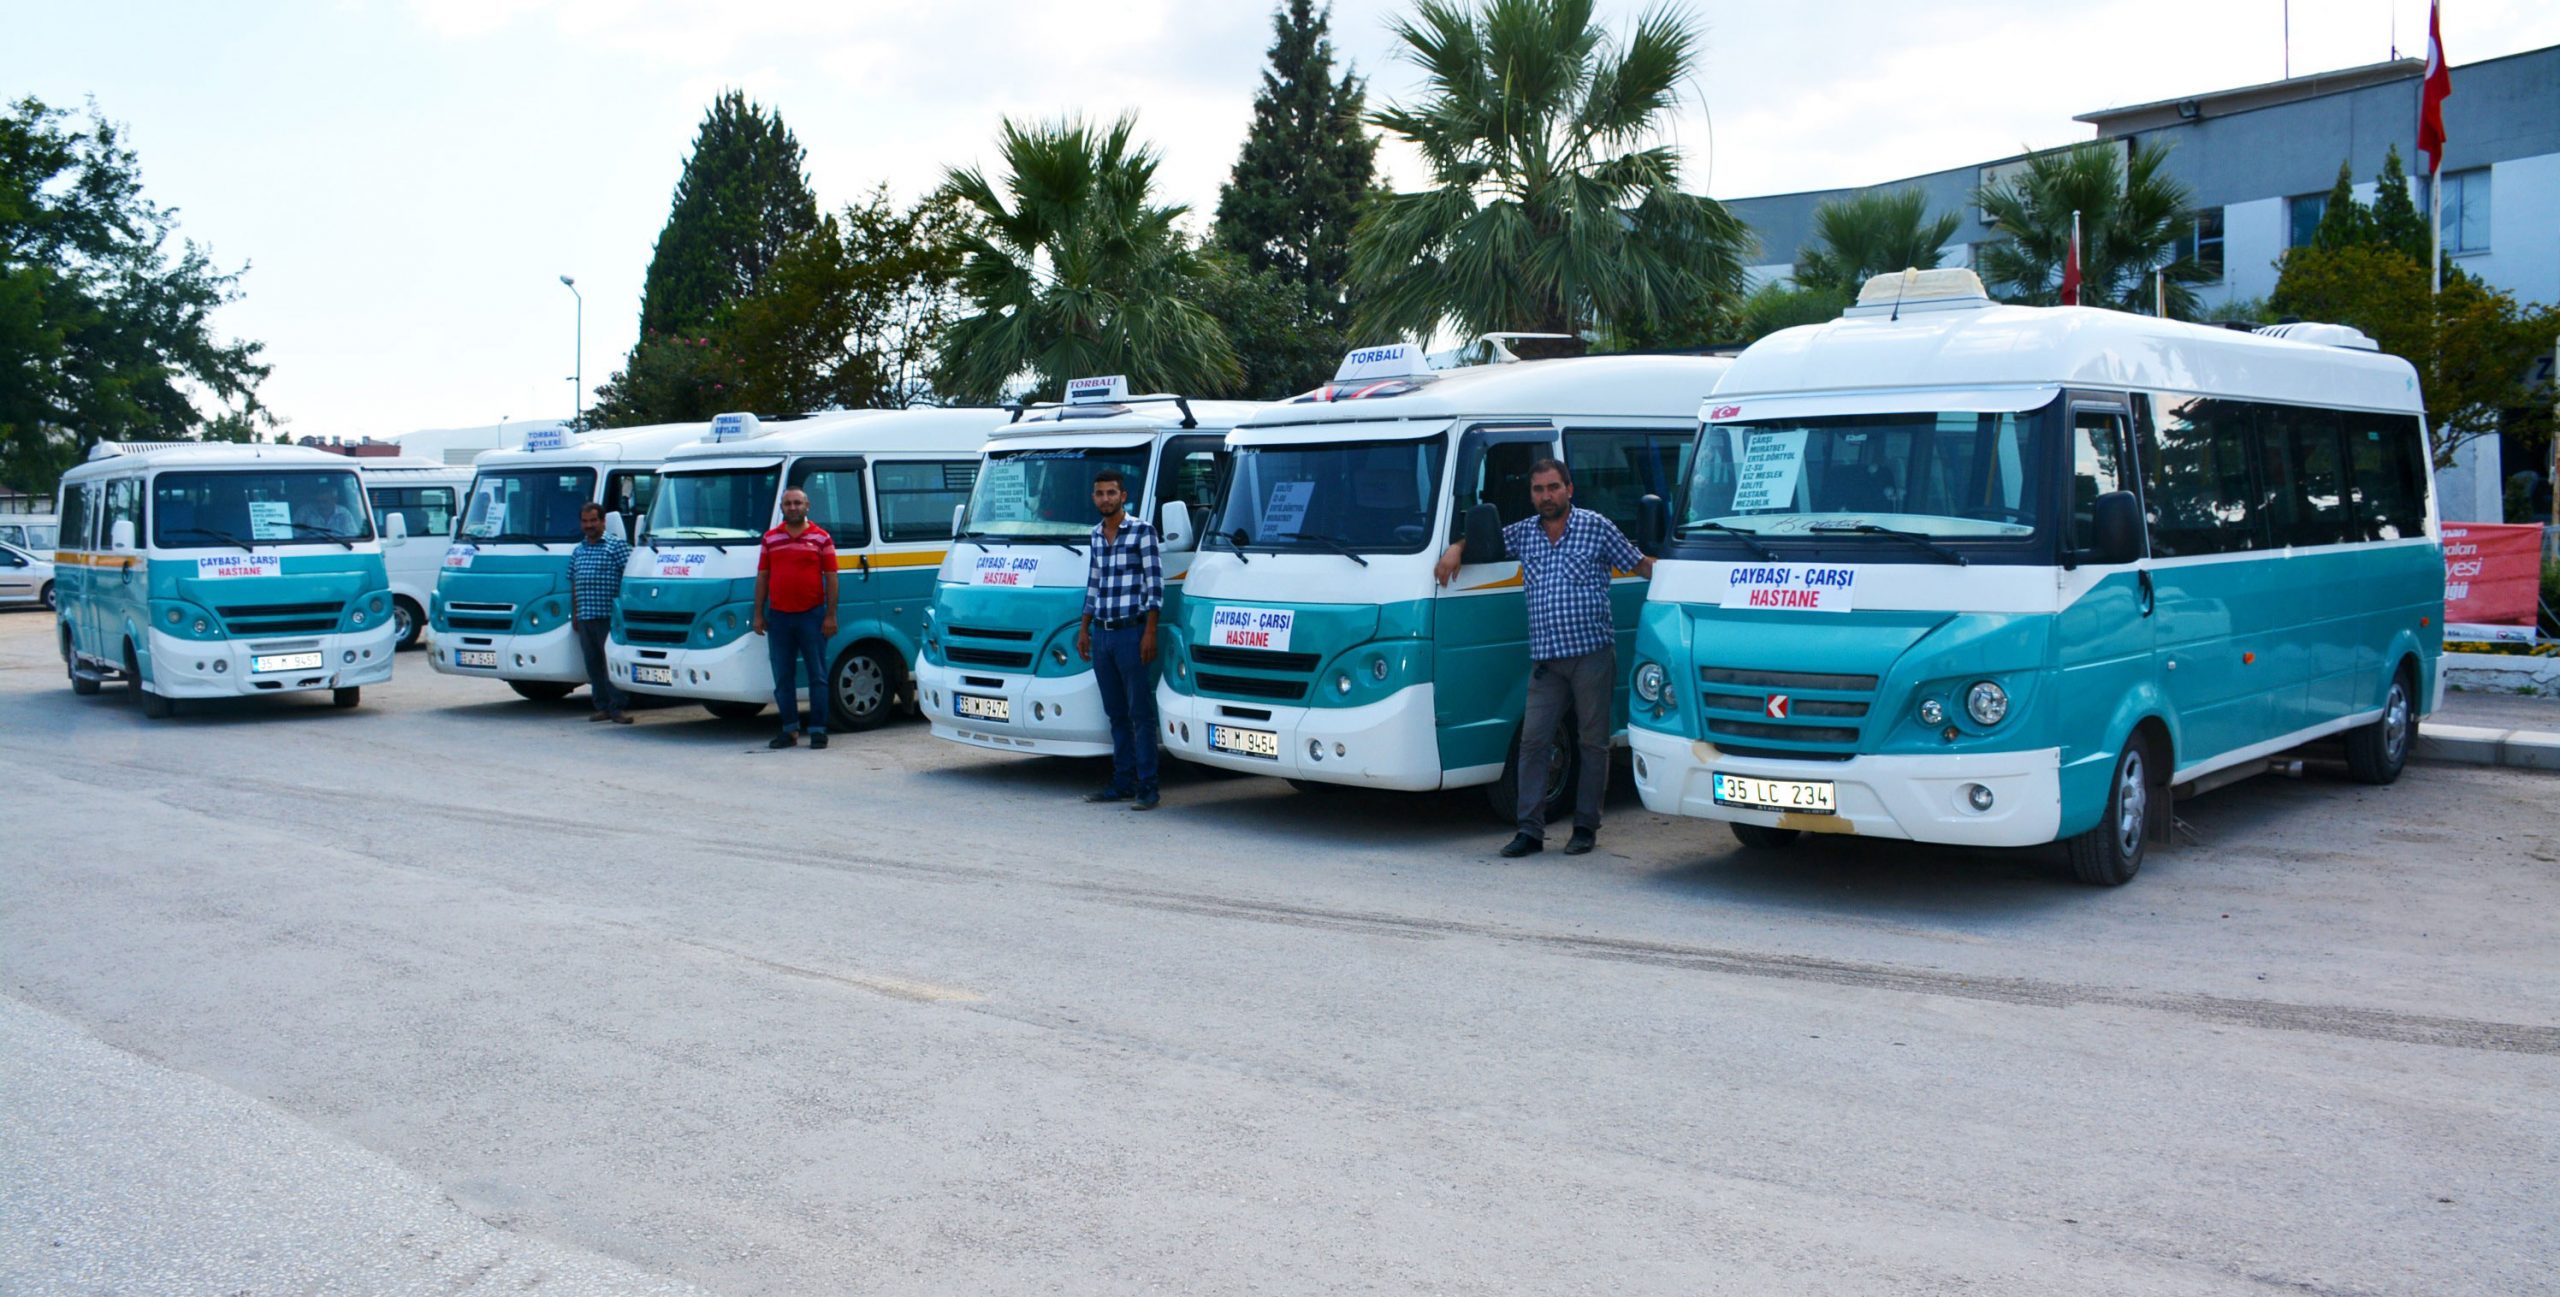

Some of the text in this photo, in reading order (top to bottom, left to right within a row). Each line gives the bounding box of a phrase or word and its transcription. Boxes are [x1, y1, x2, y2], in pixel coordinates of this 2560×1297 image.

[1351, 348, 1404, 364] TORBALI
[1071, 378, 1117, 388] TORBALI
[1751, 436, 1772, 445] ÇARŞI
[1750, 444, 1786, 453] MURATBEY
[1755, 470, 1783, 479] MESLEK
[1738, 490, 1768, 498] HASTANE
[1735, 499, 1770, 507] MEZARLIK
[200, 556, 240, 568] ÇAYBAŞI
[249, 556, 278, 566] ÇARŞI
[976, 557, 1007, 571] ÇAYBAŞI
[1012, 558, 1038, 573] ÇARŞI
[218, 567, 262, 577] HASTANE
[663, 566, 690, 576] HASTANE
[983, 571, 1019, 585] HASTANE
[1730, 568, 1791, 588] ÇAYBAŞI
[1805, 568, 1854, 590] ÇARŞI
[1749, 589, 1820, 608] HASTANE
[1214, 611, 1251, 630] ÇAYBAŞI
[1259, 613, 1291, 632] ÇARŞI
[1226, 630, 1270, 648] HASTANE
[260, 658, 273, 670] 35
[294, 654, 319, 667] 9457
[960, 697, 969, 712] 35
[986, 700, 1007, 717] 9474
[1215, 728, 1226, 746] 35
[1235, 731, 1241, 749] M
[1248, 733, 1275, 754] 9454
[1727, 779, 1828, 806] 35 LC 234
